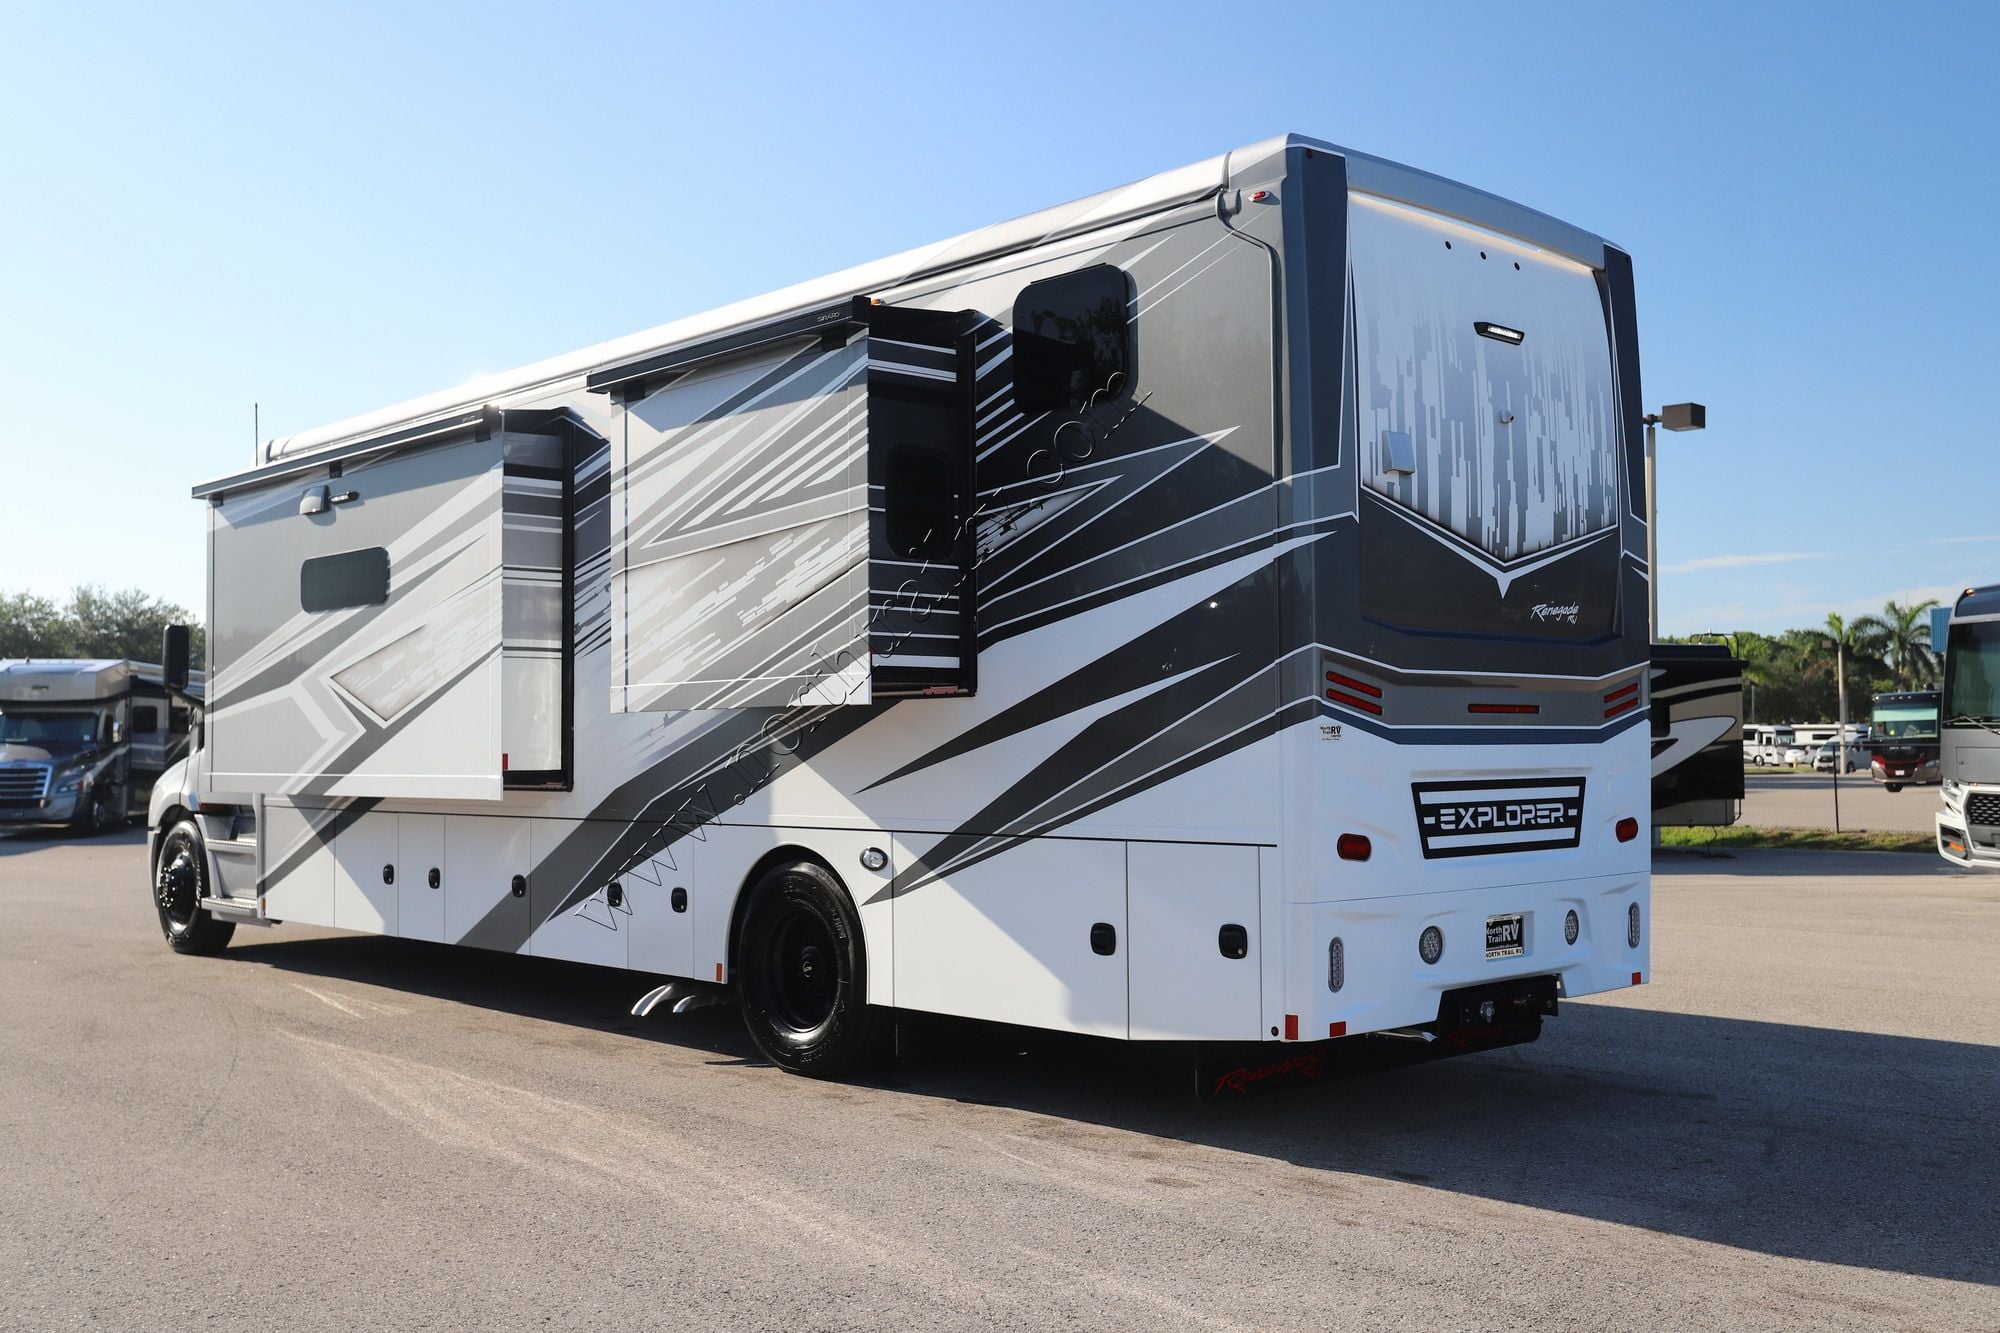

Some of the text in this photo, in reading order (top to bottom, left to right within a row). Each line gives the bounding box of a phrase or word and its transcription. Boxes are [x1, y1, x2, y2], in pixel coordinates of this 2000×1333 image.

[1530, 601, 1580, 622] Renegade
[1440, 803, 1564, 830] EXPLORER
[1488, 934, 1503, 944] Trail
[1502, 922, 1520, 942] RV
